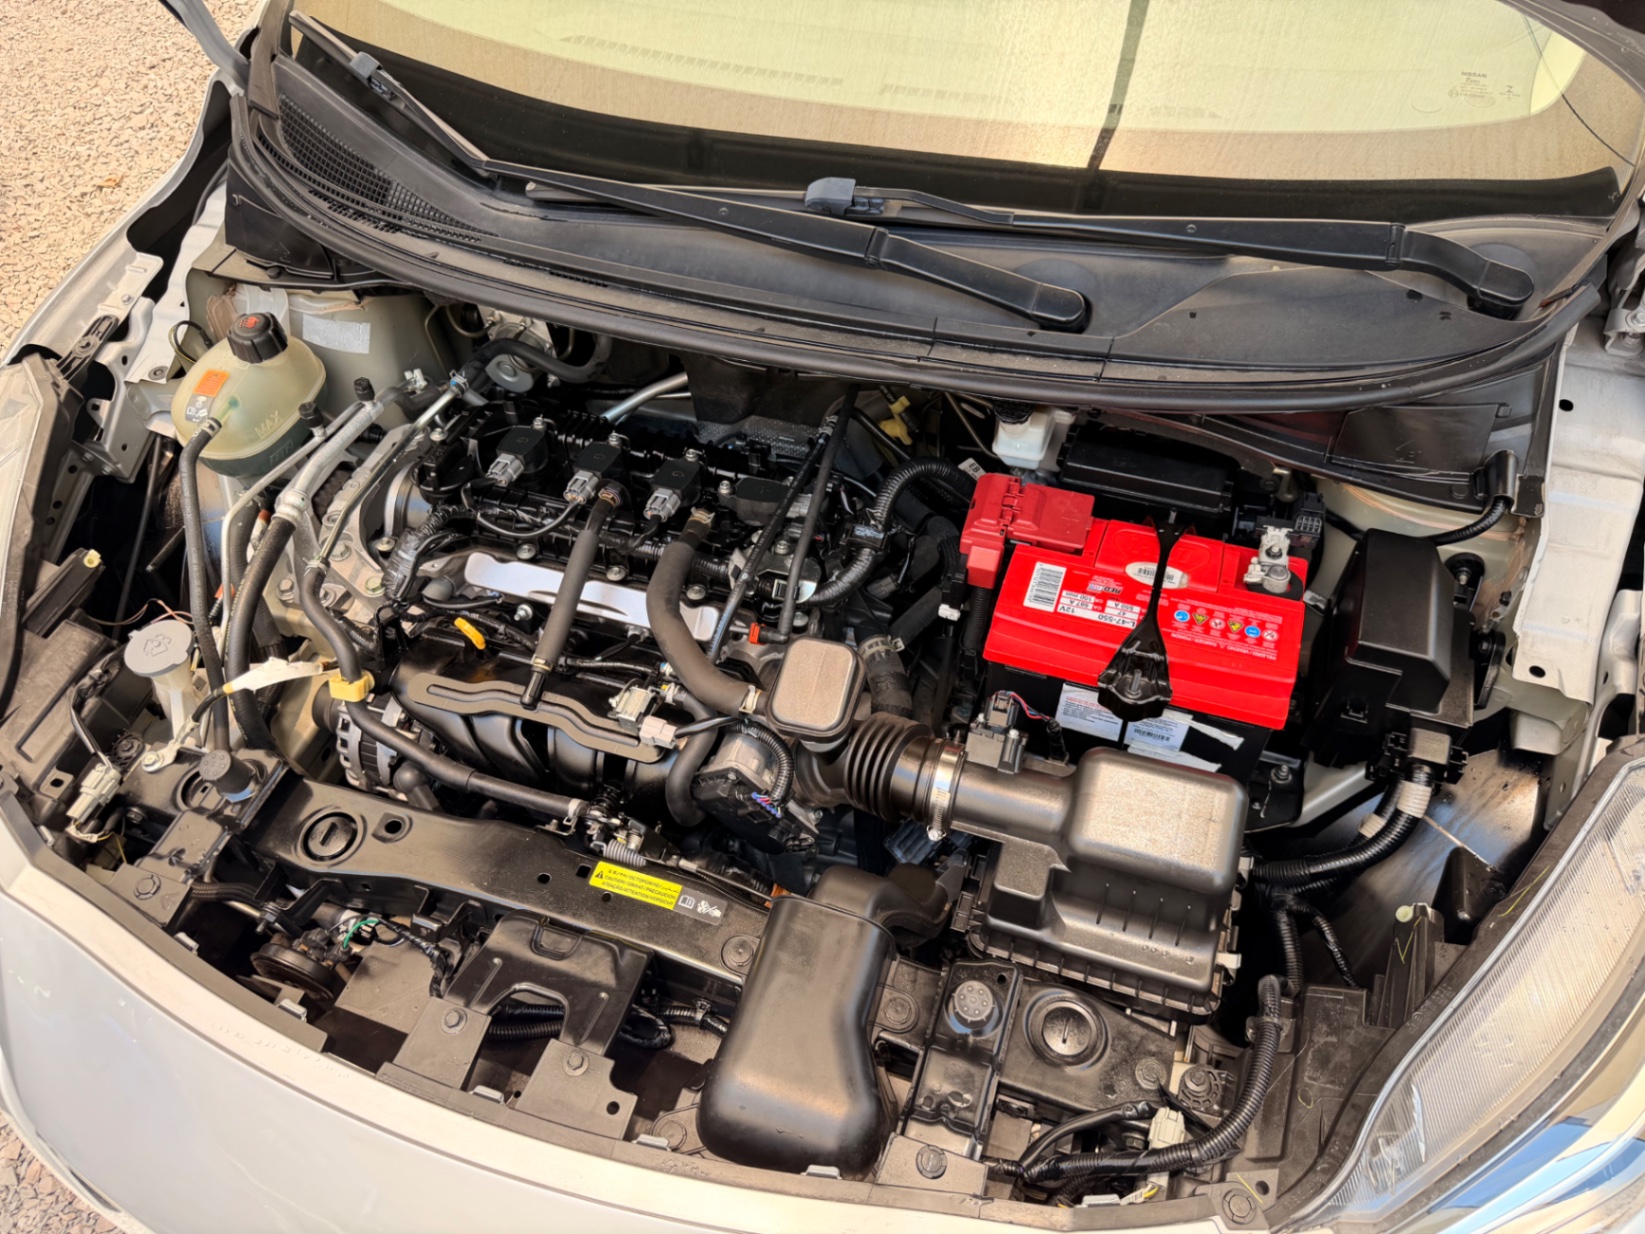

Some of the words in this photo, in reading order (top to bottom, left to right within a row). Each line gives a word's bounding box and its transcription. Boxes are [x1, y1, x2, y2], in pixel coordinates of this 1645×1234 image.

[255, 410, 282, 440] MAX
[1059, 605, 1075, 613] 12V
[1097, 614, 1135, 627] L-47-550
